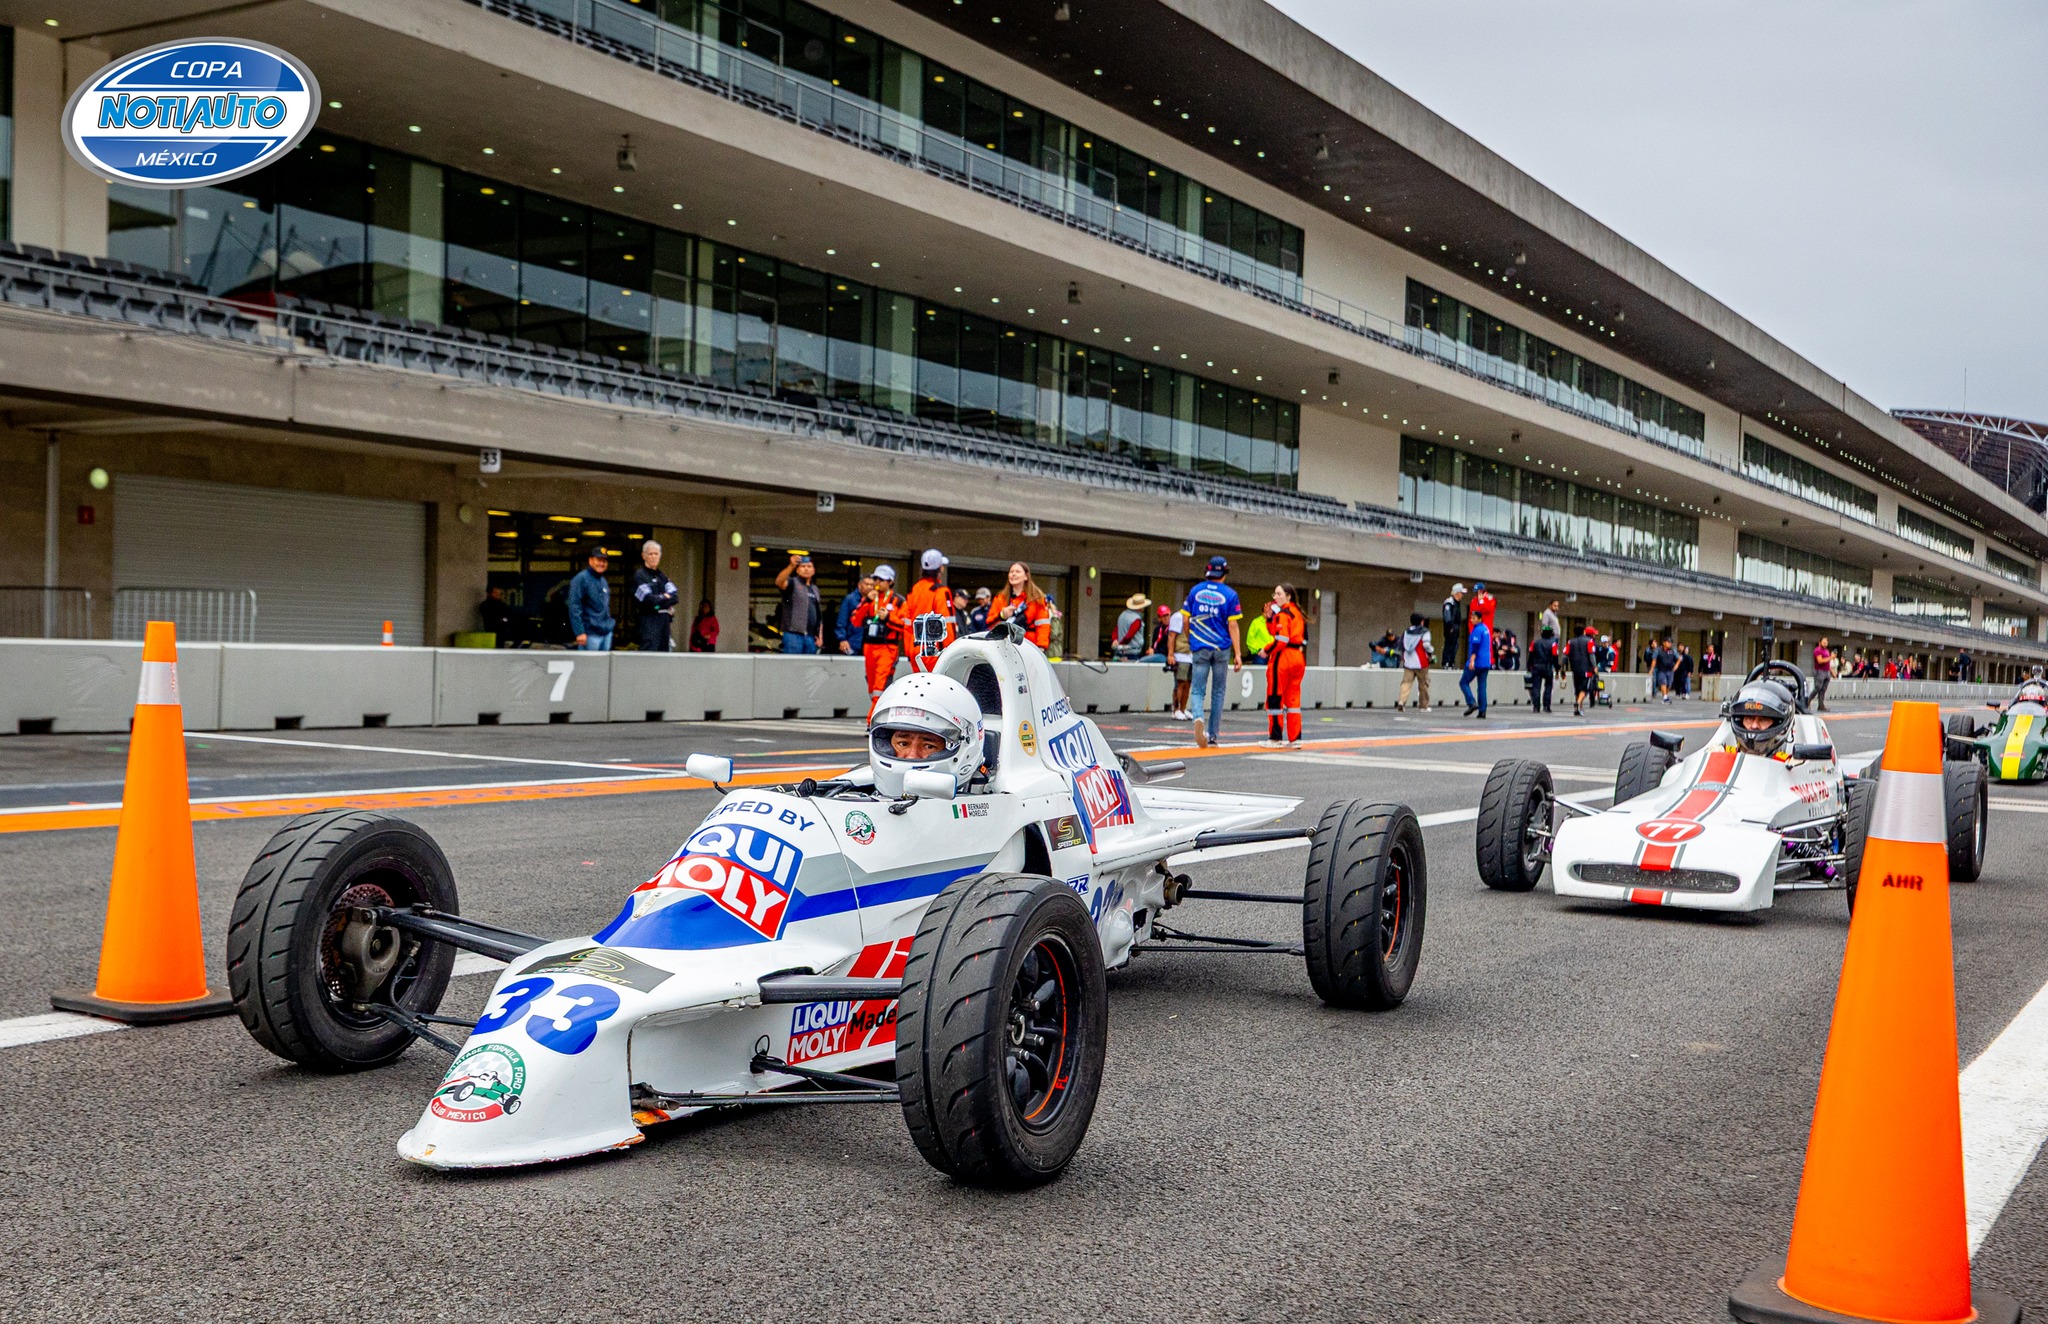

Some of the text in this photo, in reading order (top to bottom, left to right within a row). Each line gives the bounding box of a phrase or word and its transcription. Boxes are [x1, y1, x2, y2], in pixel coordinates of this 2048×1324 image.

[482, 452, 498, 465] 33
[818, 495, 832, 507] 32
[1024, 520, 1037, 531] 31
[547, 661, 574, 701] 7
[1241, 671, 1253, 698] 9
[1050, 724, 1097, 770] LIQUI
[1079, 767, 1119, 819] MOLY
[705, 800, 815, 832] ERED BY
[1646, 822, 1697, 839] 77
[683, 825, 797, 887] QUI
[646, 856, 787, 927] MOLY
[1882, 874, 1924, 891] AHR
[533, 966, 634, 984] SPEEDFEST
[470, 977, 621, 1056] 33
[793, 1001, 849, 1034] LIQUI
[789, 1026, 846, 1063] MOLY
[486, 1044, 520, 1064] FORMULA
[513, 1065, 524, 1090] FORD
[432, 1101, 447, 1116] CLUB
